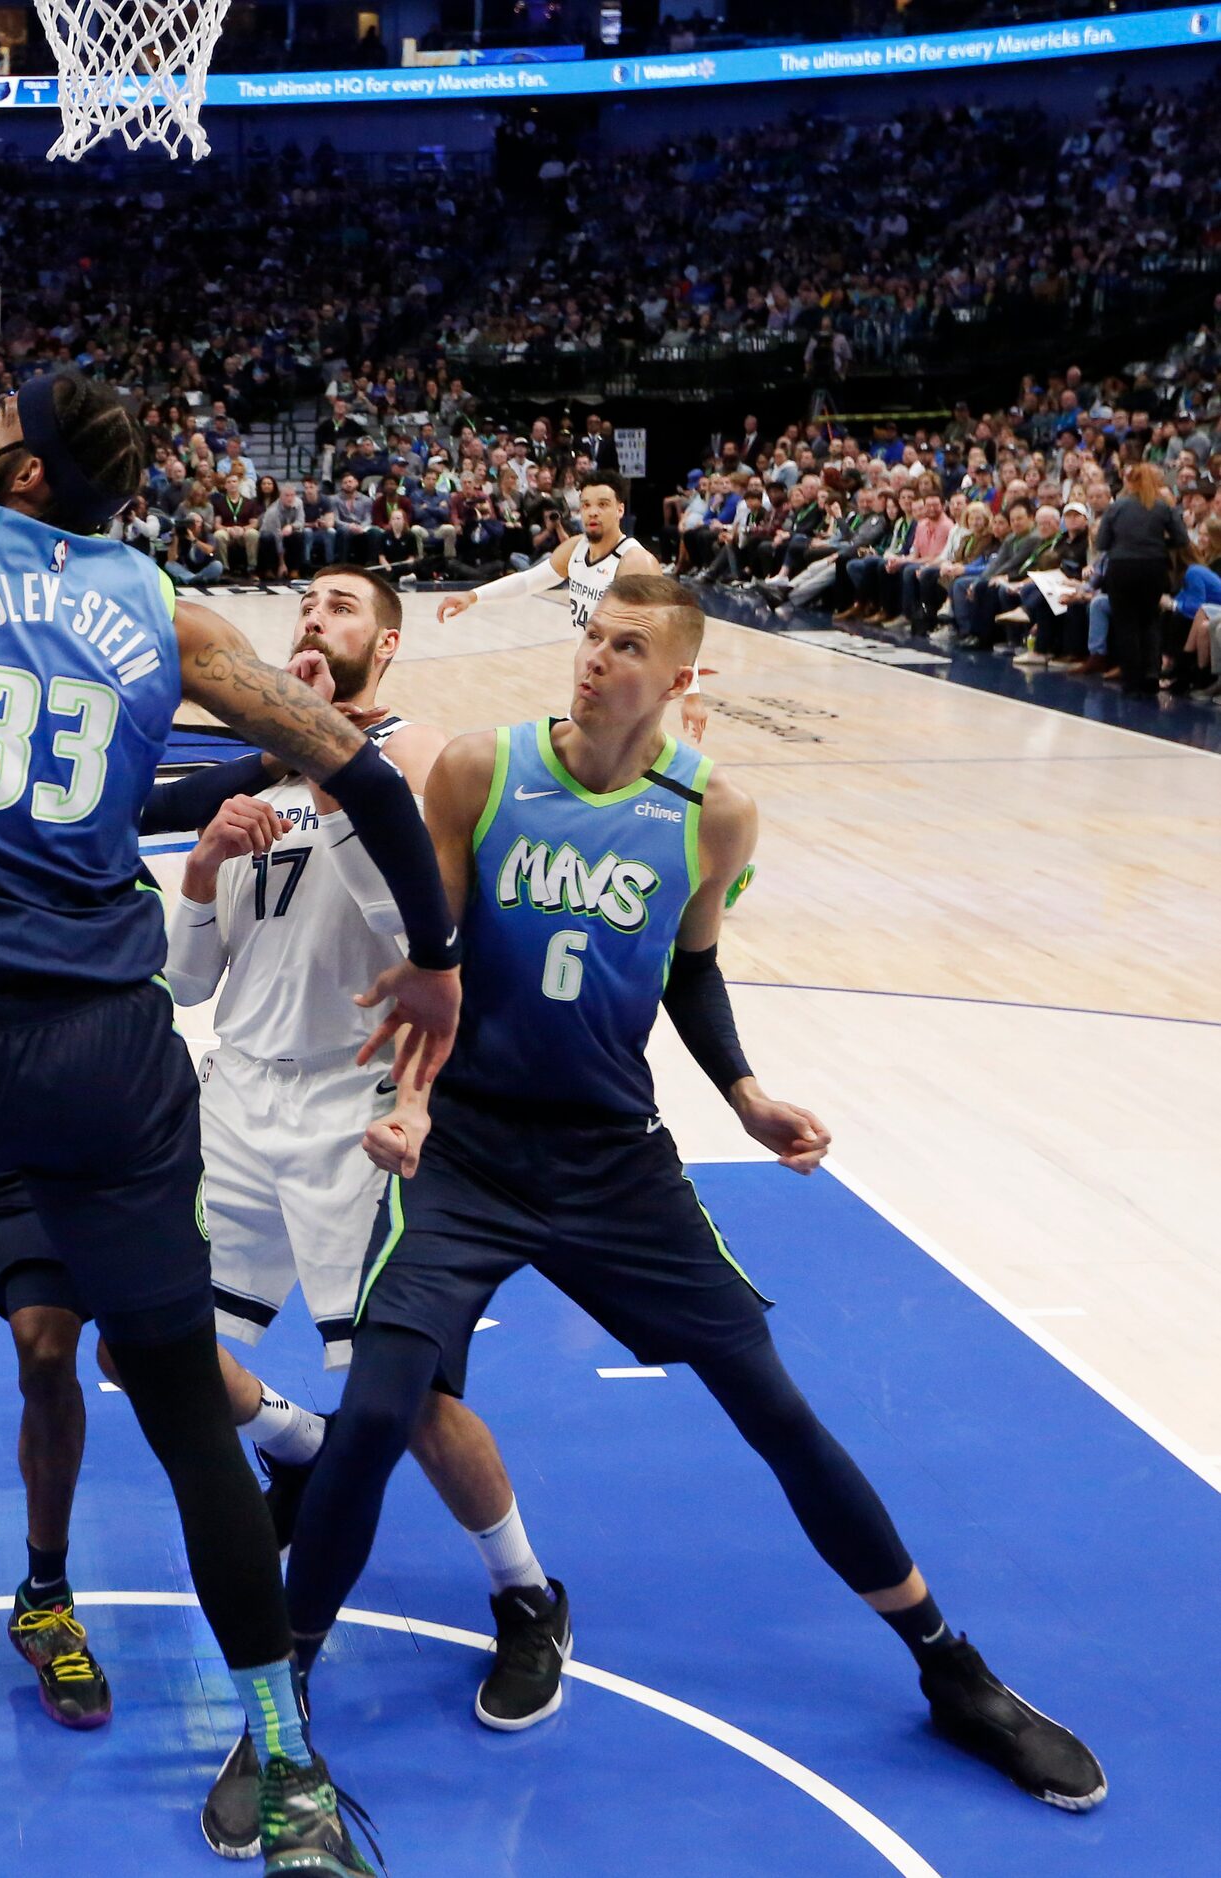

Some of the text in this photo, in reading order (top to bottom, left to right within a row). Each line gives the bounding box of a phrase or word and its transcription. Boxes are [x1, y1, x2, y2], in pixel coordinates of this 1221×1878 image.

[780, 26, 1115, 72] The ultimate HQ for every Mavericks fan.
[238, 71, 549, 98] The ultimate HQ for every Mavericks fan.
[643, 63, 697, 80] Walmart
[33, 90, 41, 103] 1
[570, 579, 605, 602] EMPHIS
[634, 801, 682, 823] chime
[251, 846, 314, 921] 17
[496, 834, 662, 934] MAVS
[541, 929, 589, 1002] 6
